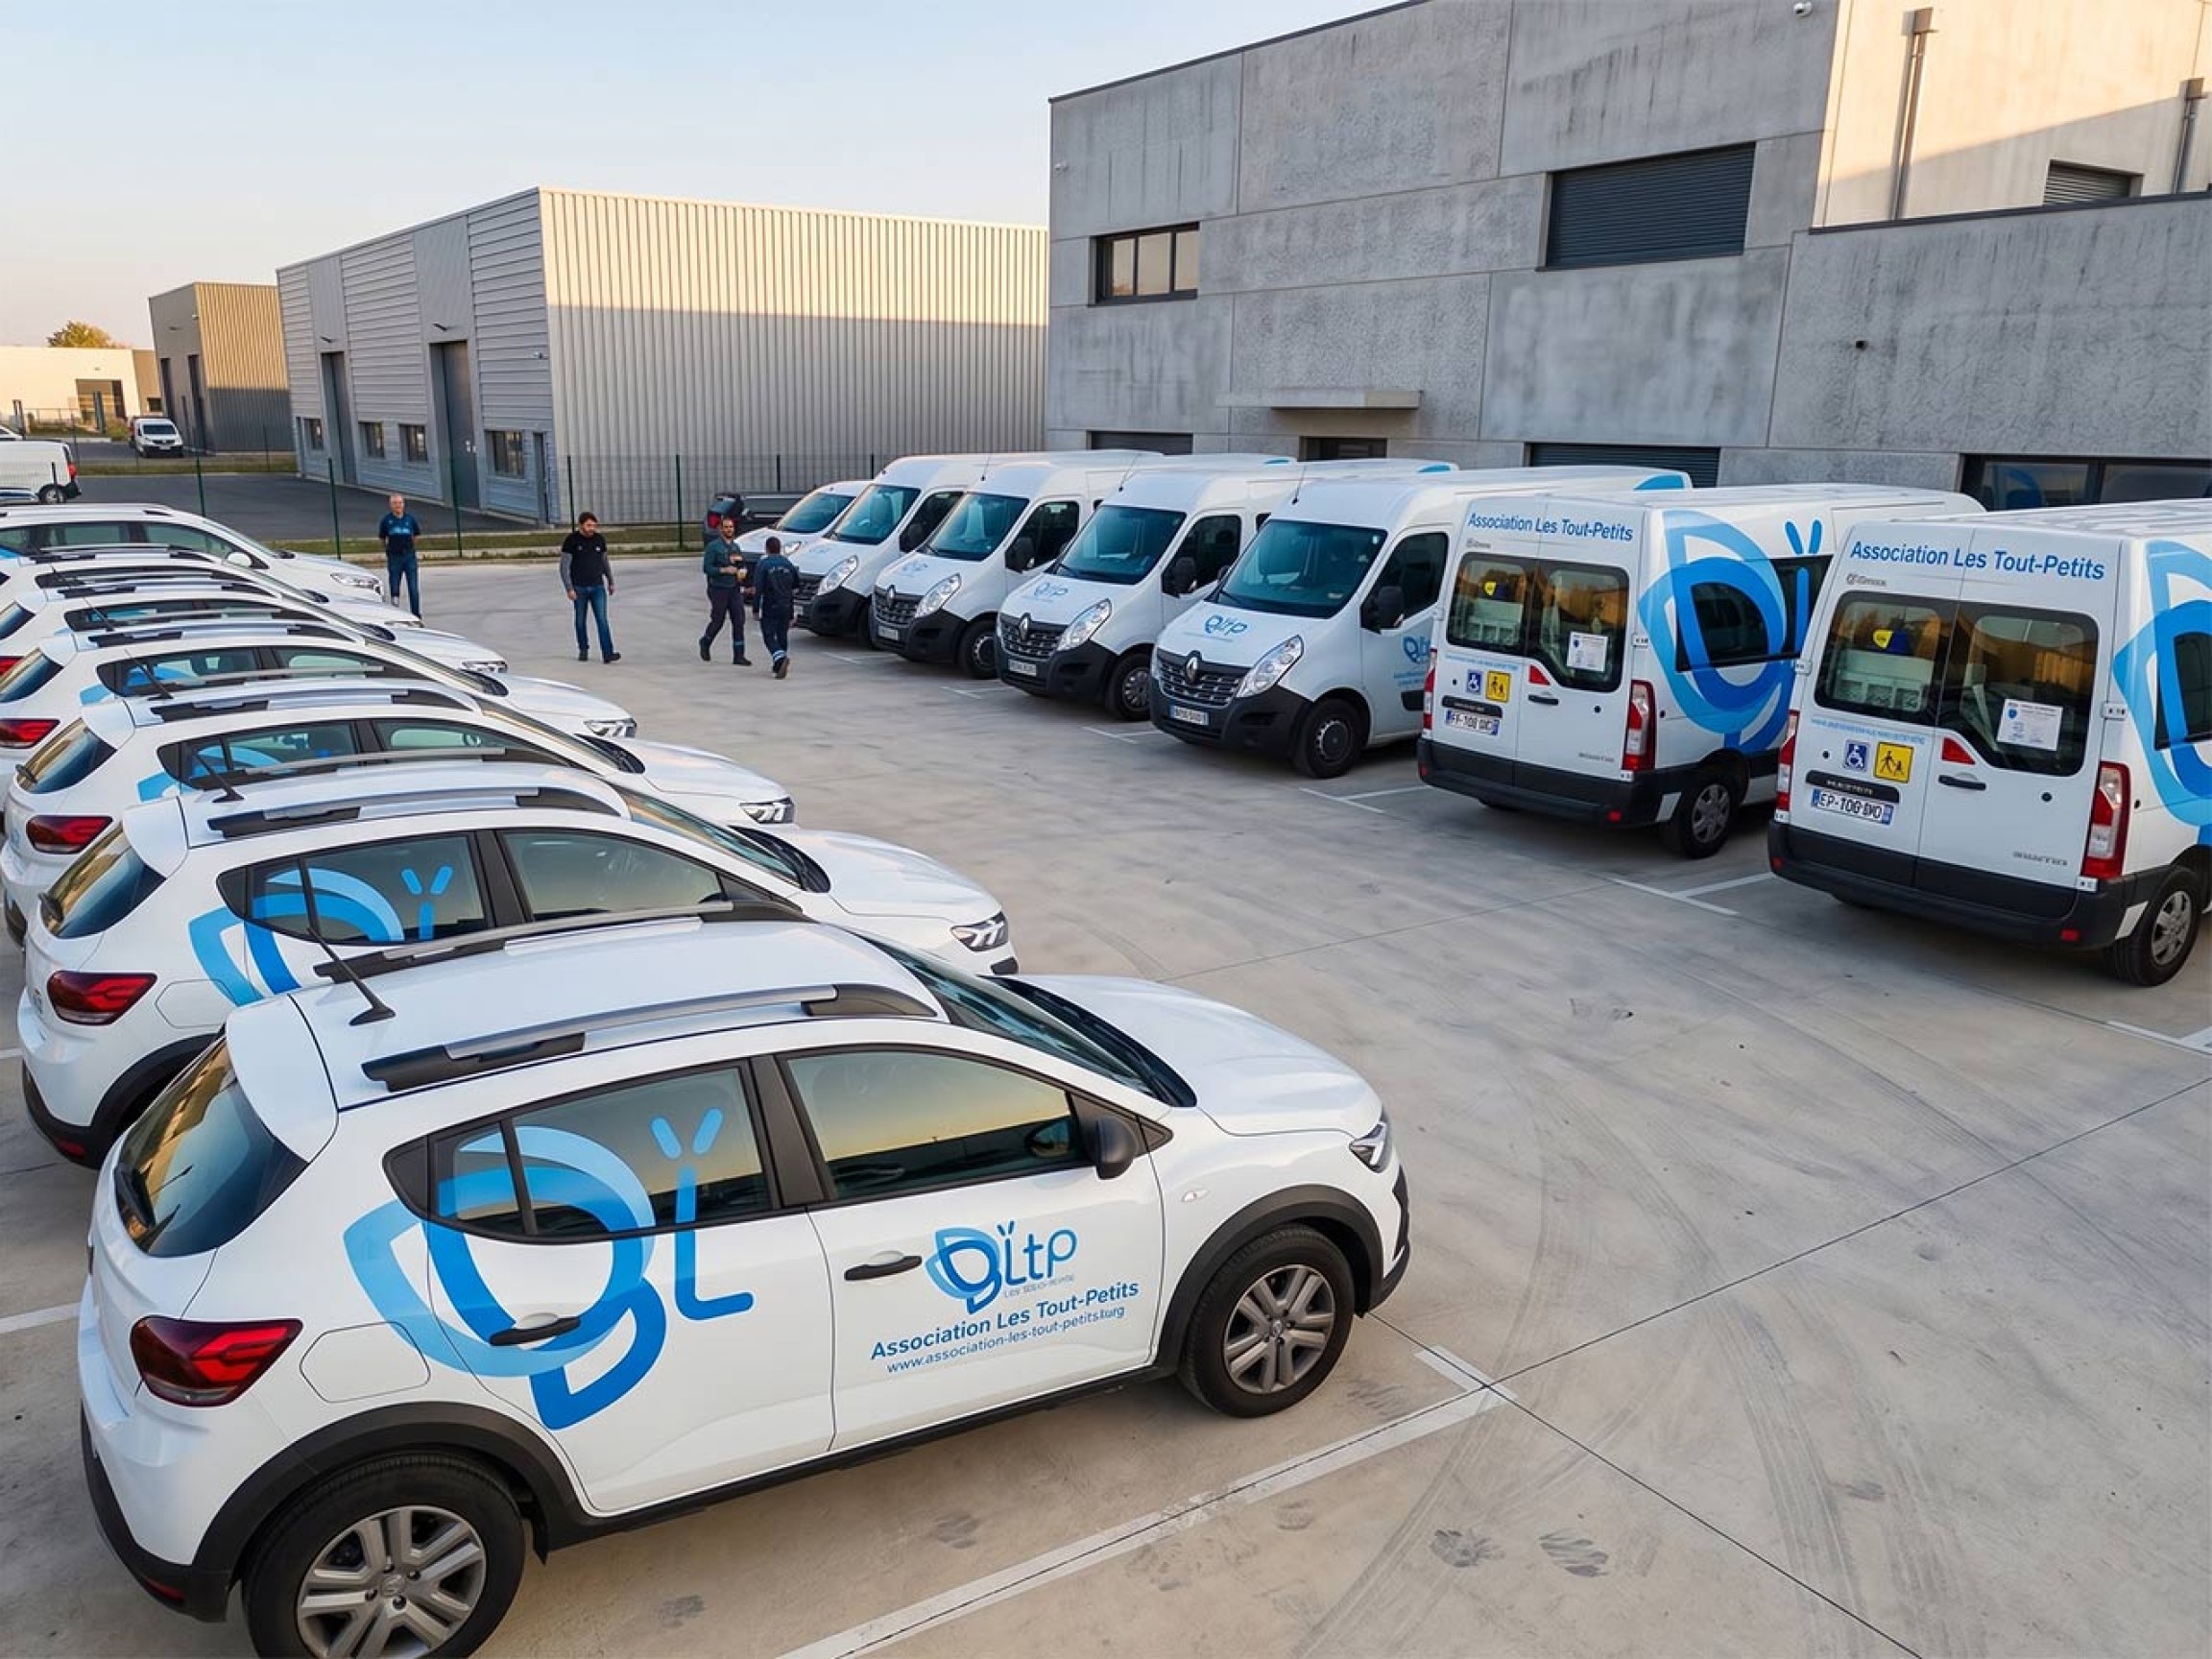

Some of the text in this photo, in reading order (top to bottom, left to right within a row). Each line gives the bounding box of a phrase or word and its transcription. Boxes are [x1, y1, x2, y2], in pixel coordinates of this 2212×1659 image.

[1469, 513, 1633, 541] Association Les Tout-Petits
[1850, 541, 2104, 580] Association Les Tout-Petits
[871, 1320, 991, 1359] Association
[997, 1310, 1030, 1330] Les
[1036, 1282, 1140, 1318] Tout-Petits
